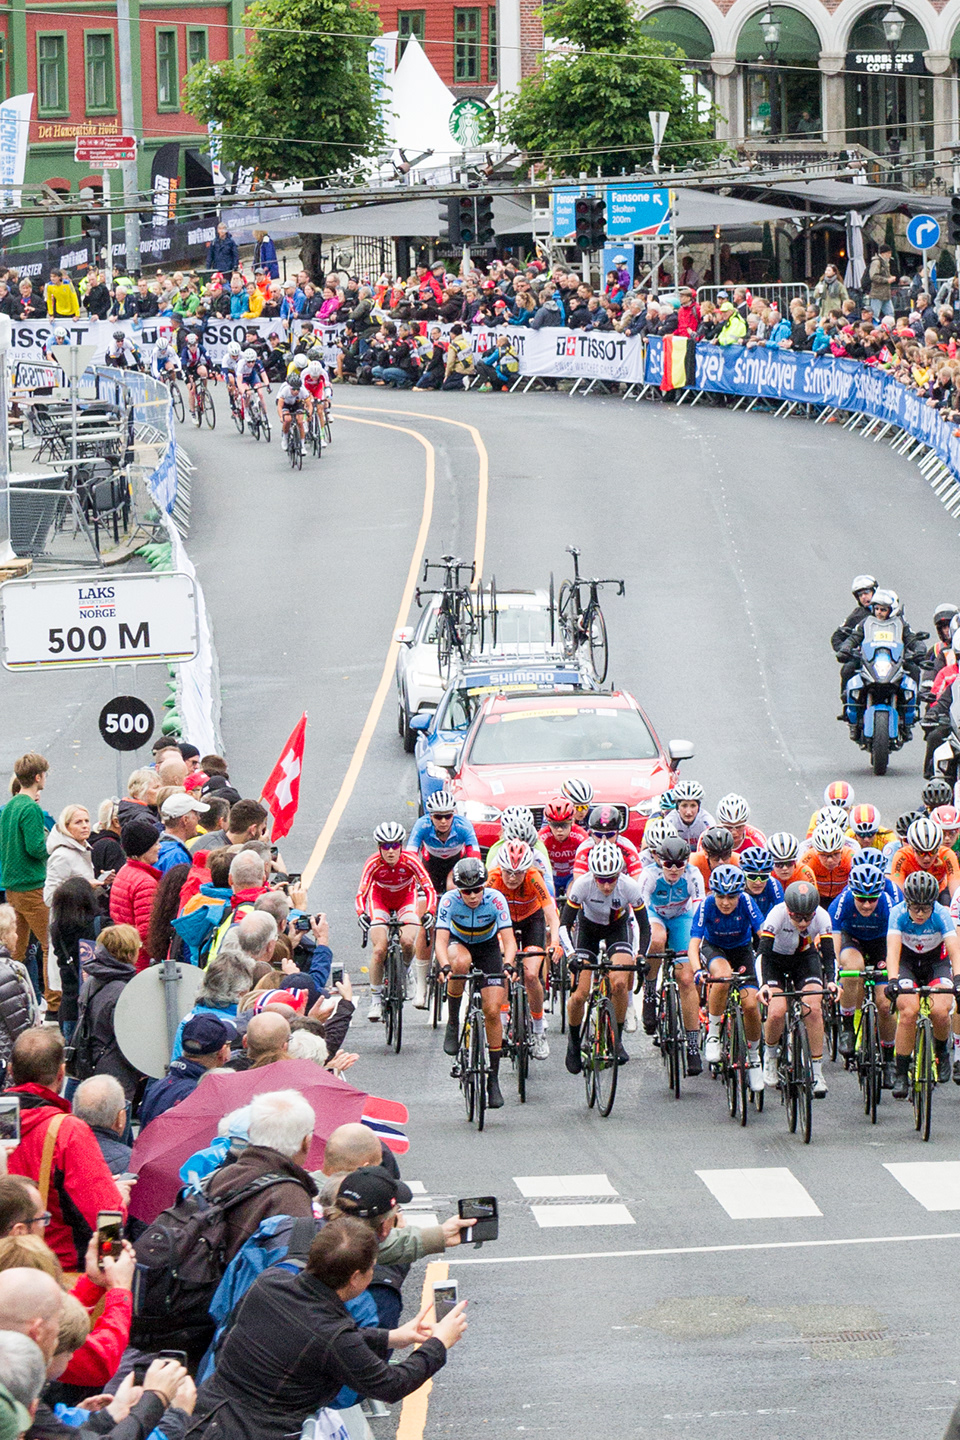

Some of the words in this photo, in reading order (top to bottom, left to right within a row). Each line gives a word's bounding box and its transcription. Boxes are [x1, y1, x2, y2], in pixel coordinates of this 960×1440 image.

[38, 125, 52, 138] Det
[98, 119, 118, 135] Hotel
[612, 192, 650, 202] Fansone
[612, 205, 636, 213] Skolten
[578, 336, 627, 360] TISSOT
[78, 587, 115, 600] LAKS
[79, 608, 116, 619] NORGE
[48, 626, 107, 653] 500
[118, 622, 150, 650] M
[490, 672, 554, 684] SHIMANO
[105, 714, 149, 734] 500
